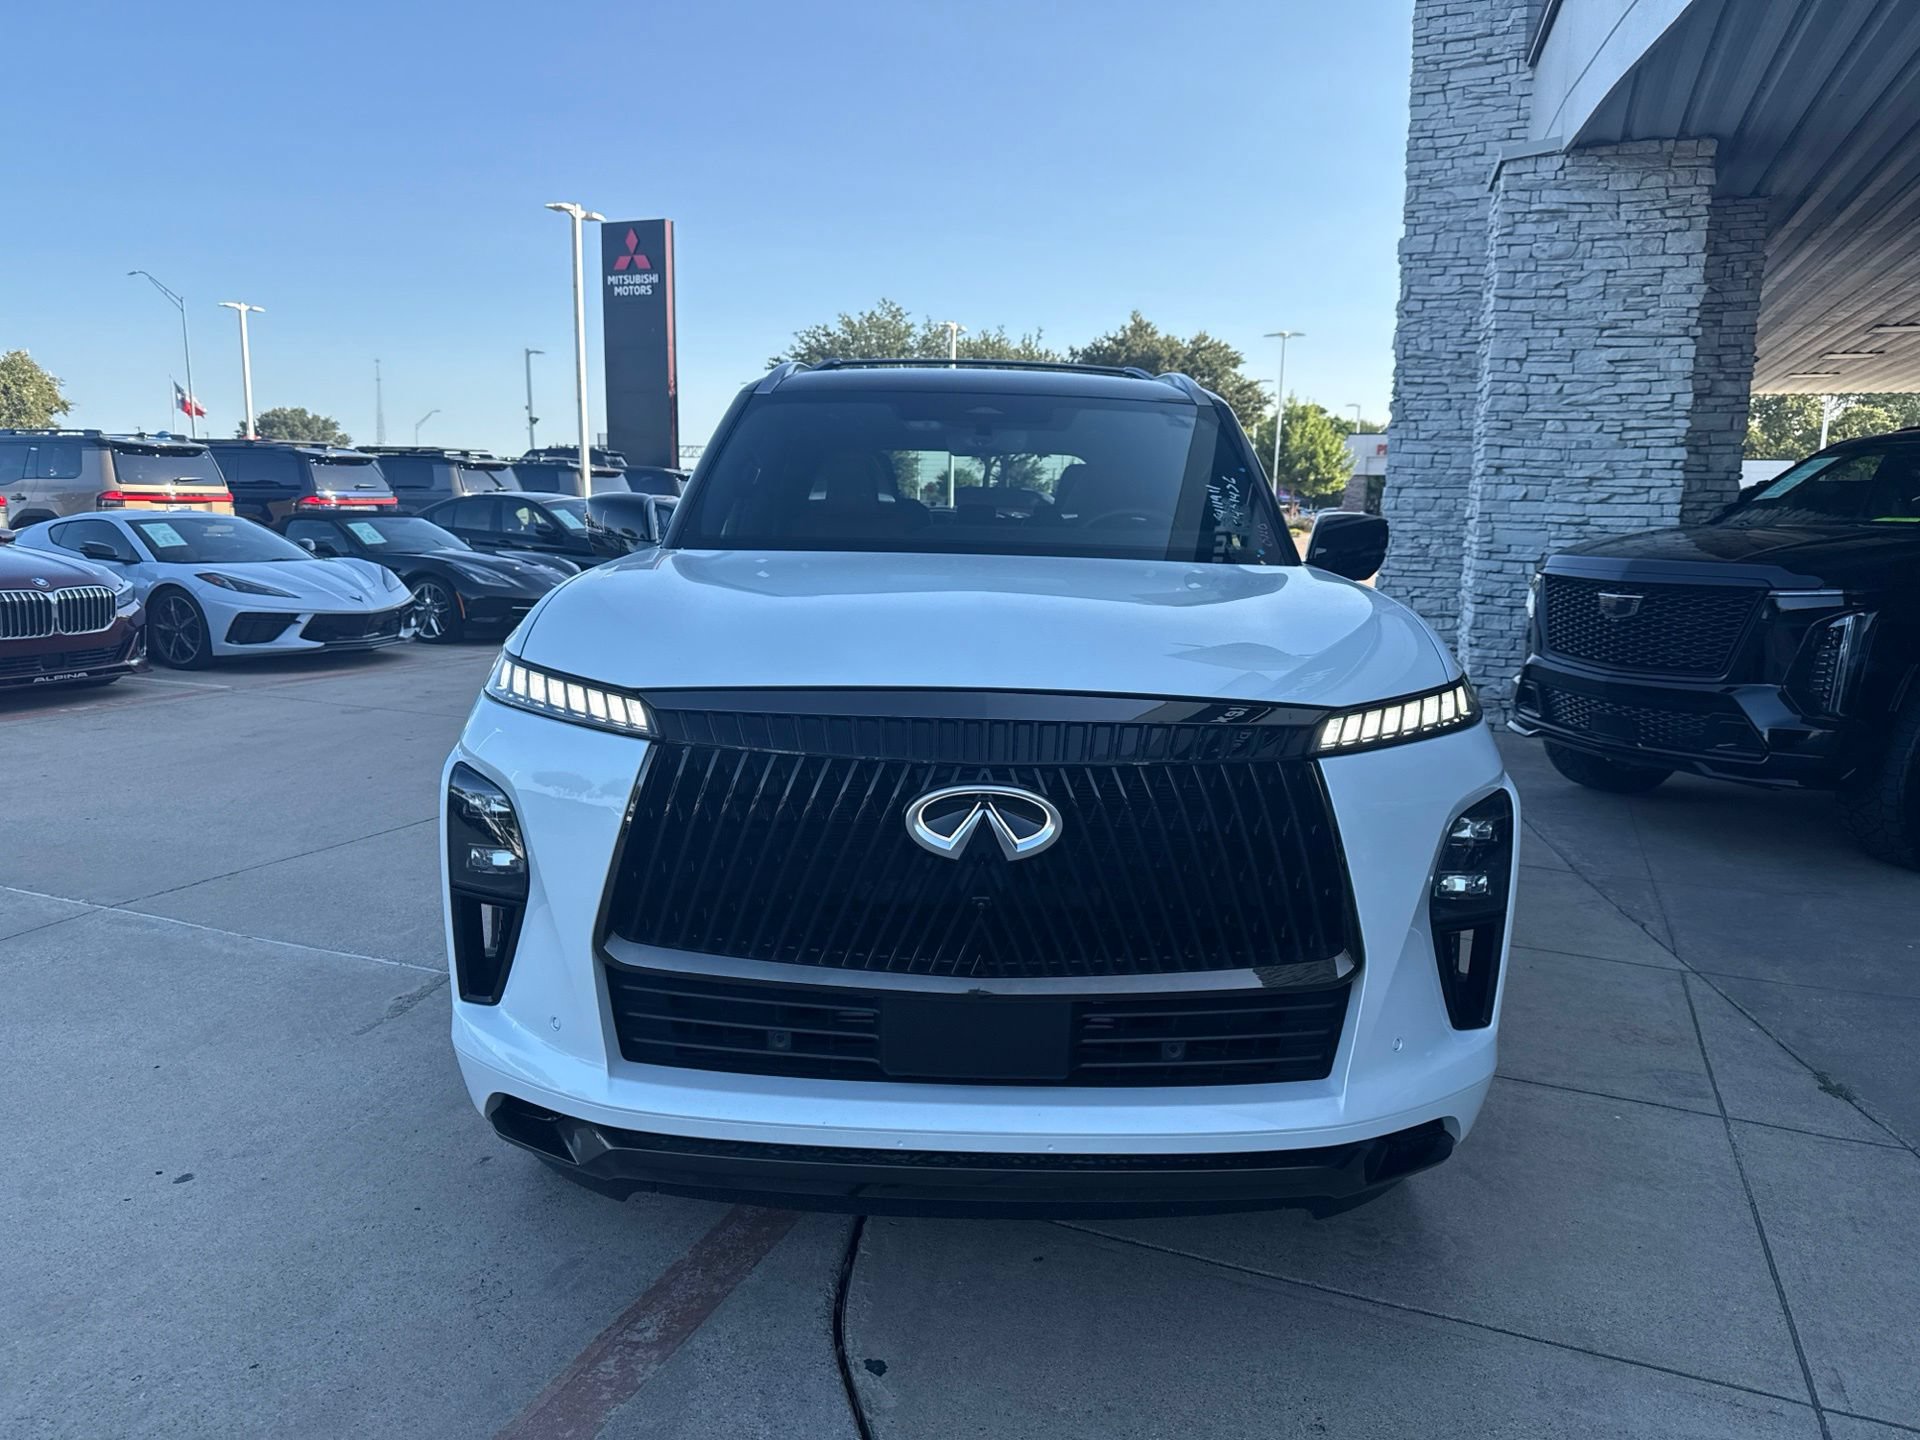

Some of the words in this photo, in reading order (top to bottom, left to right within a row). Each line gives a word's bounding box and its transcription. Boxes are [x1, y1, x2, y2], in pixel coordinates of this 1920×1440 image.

[607, 273, 659, 285] MITSUBISHI
[614, 285, 653, 296] MOTORS
[33, 672, 88, 683] ALPINA
